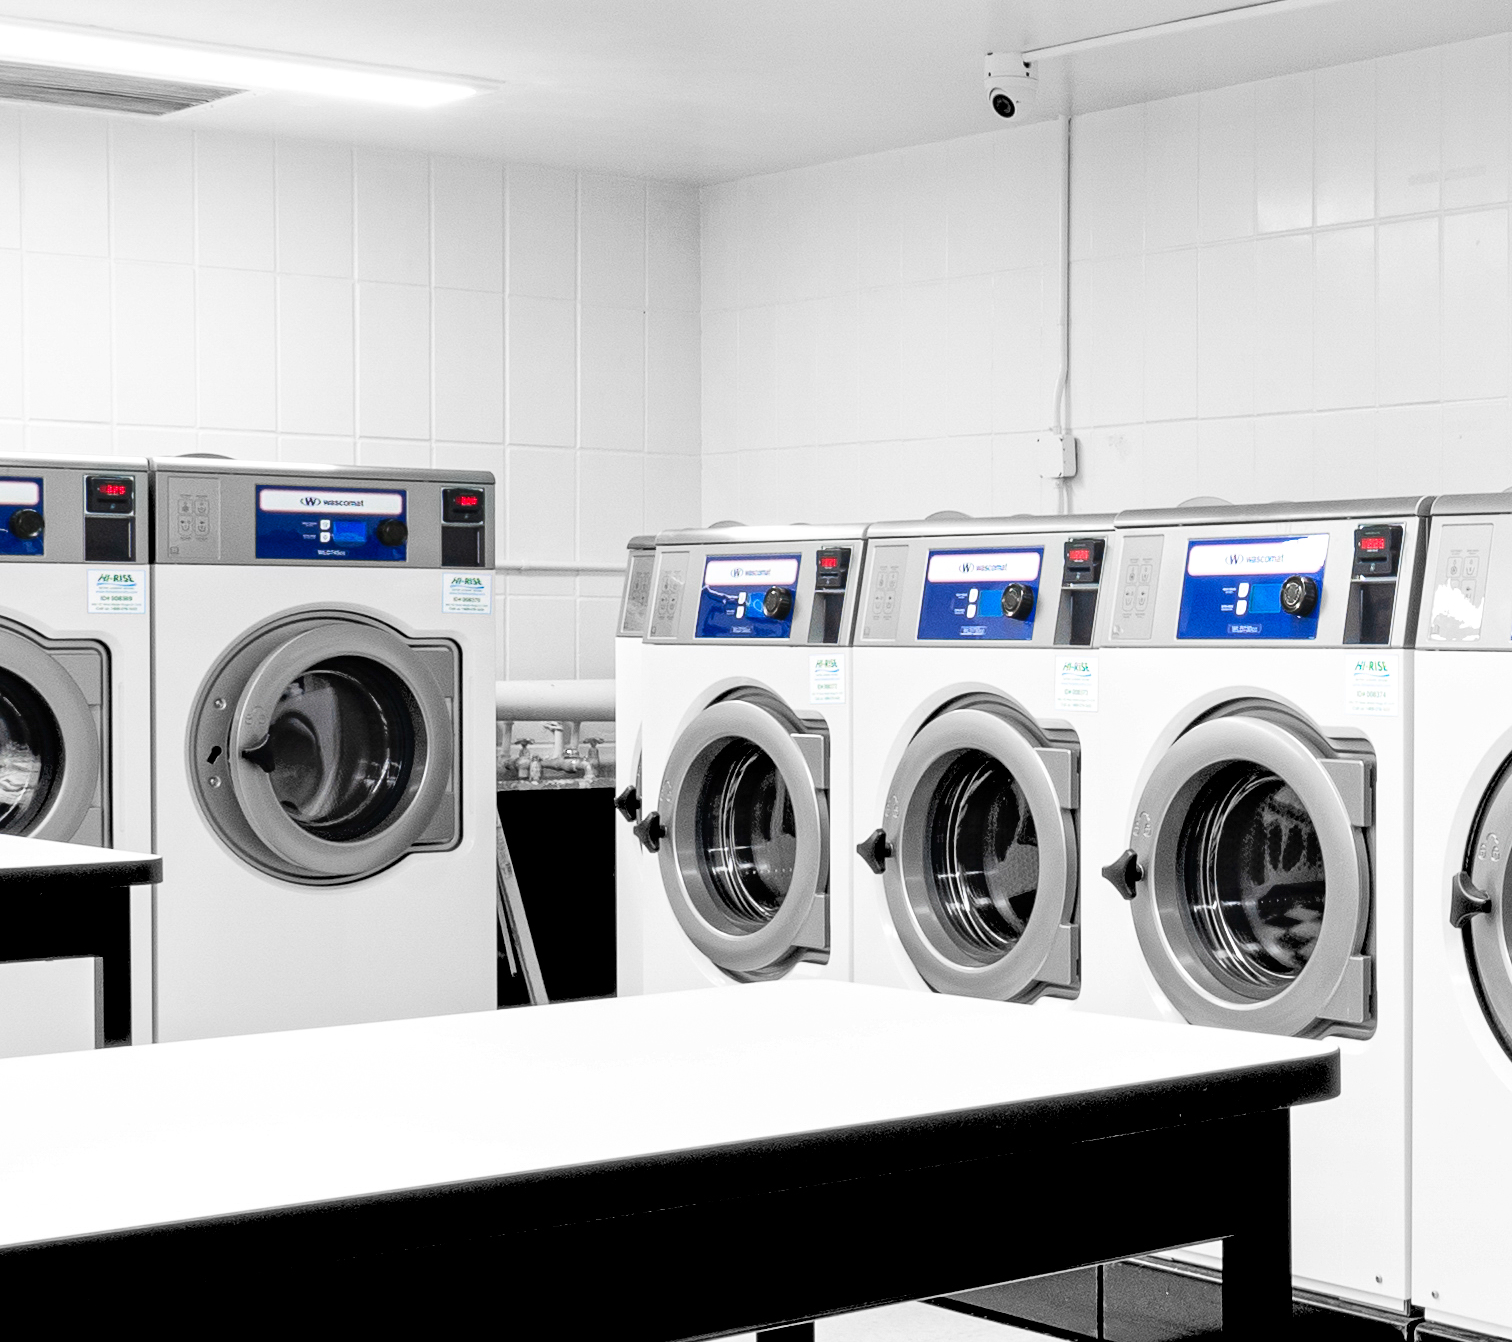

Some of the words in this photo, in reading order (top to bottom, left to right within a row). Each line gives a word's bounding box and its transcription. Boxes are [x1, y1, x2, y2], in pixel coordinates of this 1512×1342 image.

[324, 499, 364, 507] wascomat
[1246, 554, 1284, 564] wascomat
[976, 564, 1007, 572] wascomat
[98, 574, 134, 582] HI-RISE
[1355, 661, 1388, 671] HI-RISE
